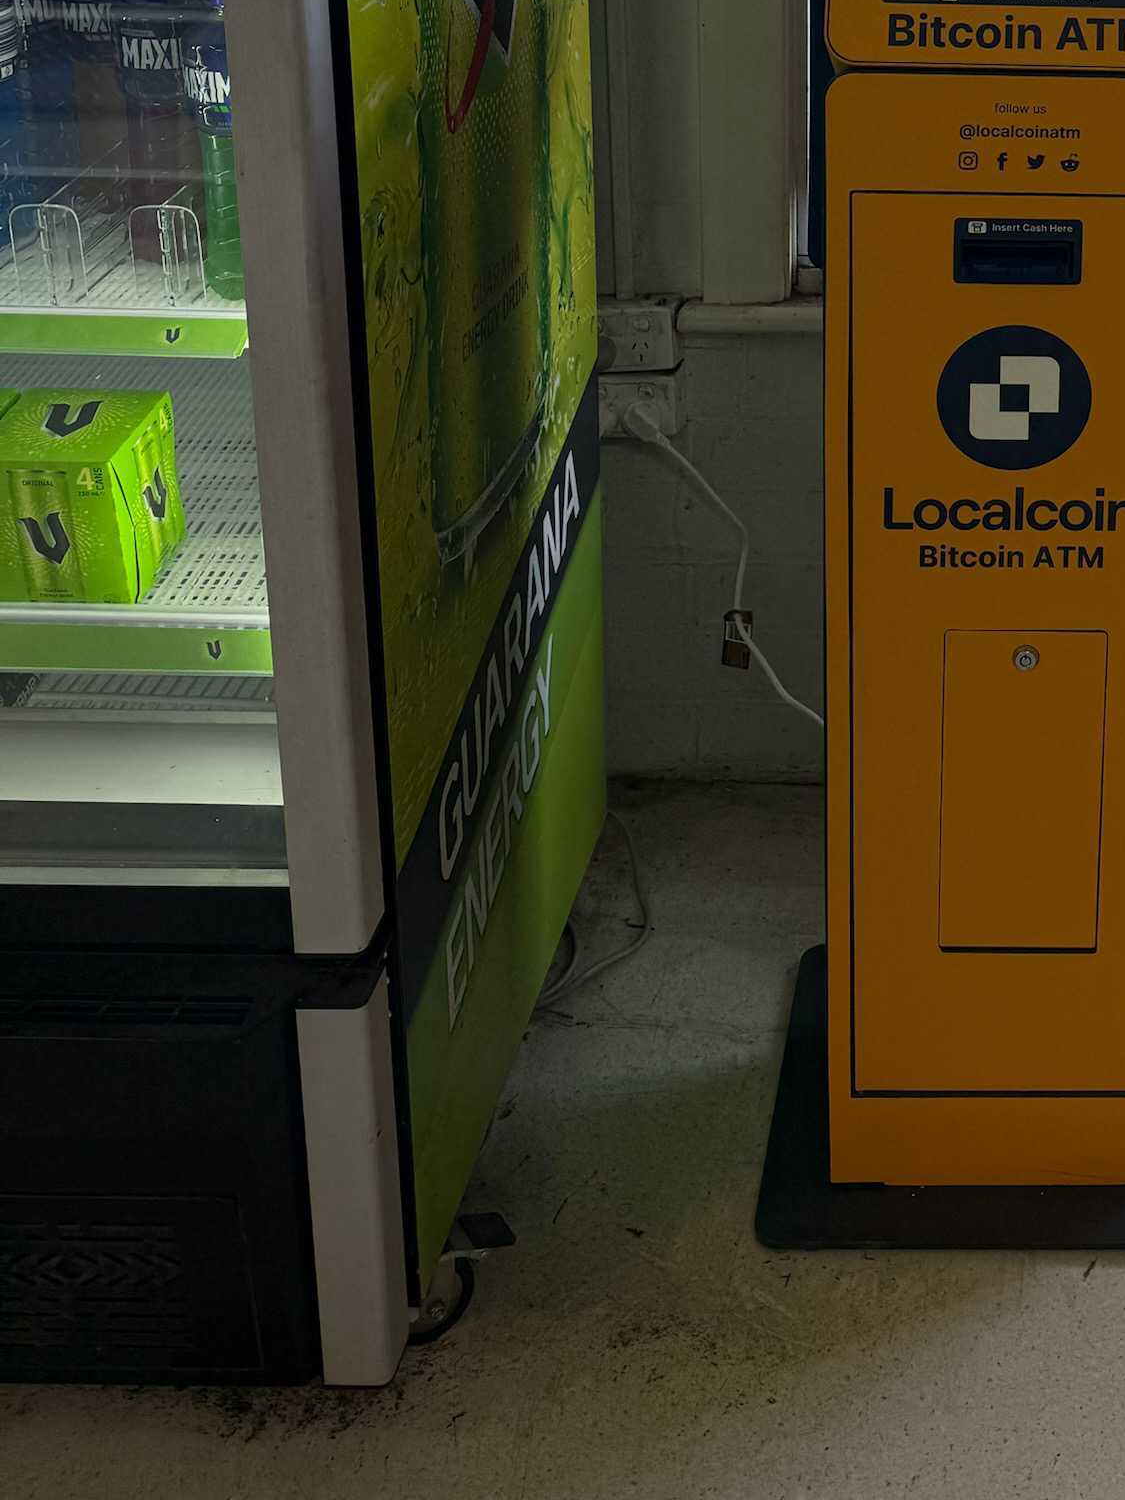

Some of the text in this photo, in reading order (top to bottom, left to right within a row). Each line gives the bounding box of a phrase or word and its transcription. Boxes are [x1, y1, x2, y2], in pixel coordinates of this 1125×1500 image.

[888, 13, 1042, 49] Bitcoin
[121, 36, 183, 70] MAXI
[994, 102, 1047, 114] follow us
[959, 124, 1081, 140] @localcoinatm
[992, 222, 1073, 233] Insert Cash Here
[76, 467, 95, 491] 4
[919, 544, 1104, 569] Bitcoin ATM
[441, 449, 580, 882] GUARANA
[447, 633, 554, 1034] ENERGY
